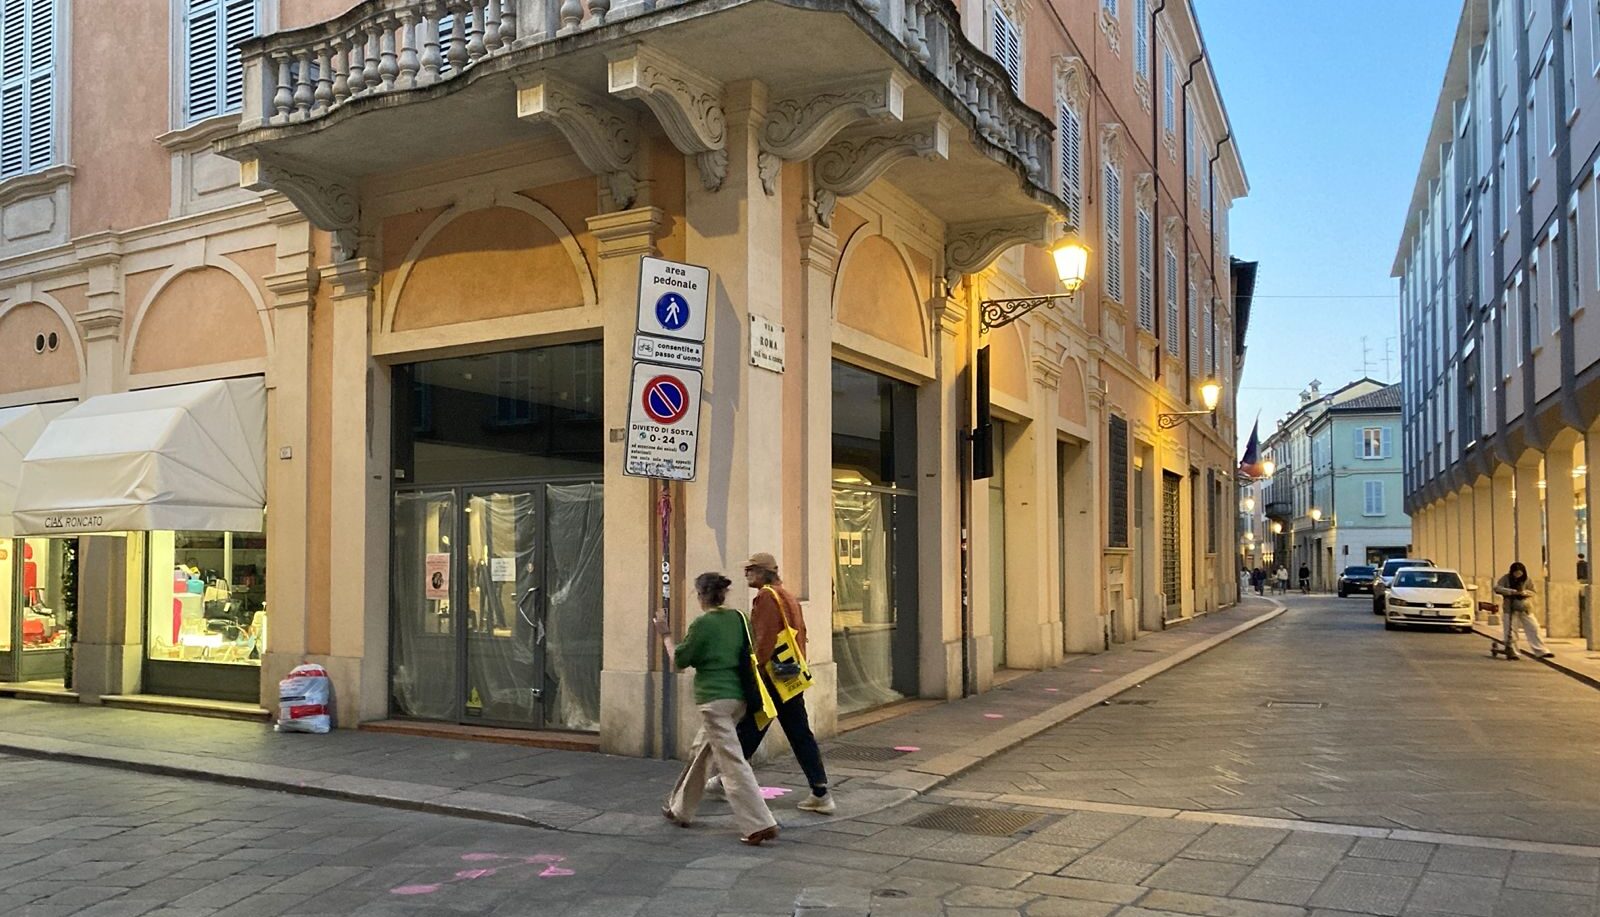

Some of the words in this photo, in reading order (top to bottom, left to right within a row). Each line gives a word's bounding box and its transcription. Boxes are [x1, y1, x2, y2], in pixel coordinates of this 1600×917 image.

[665, 266, 686, 276] area
[653, 276, 697, 290] pedonale
[657, 343, 694, 354] consentite
[760, 336, 778, 350] ROMA
[655, 351, 675, 359] passo
[676, 353, 702, 362] d'uomo
[632, 424, 660, 432] DIVIETO
[66, 516, 102, 527] RONCATO
